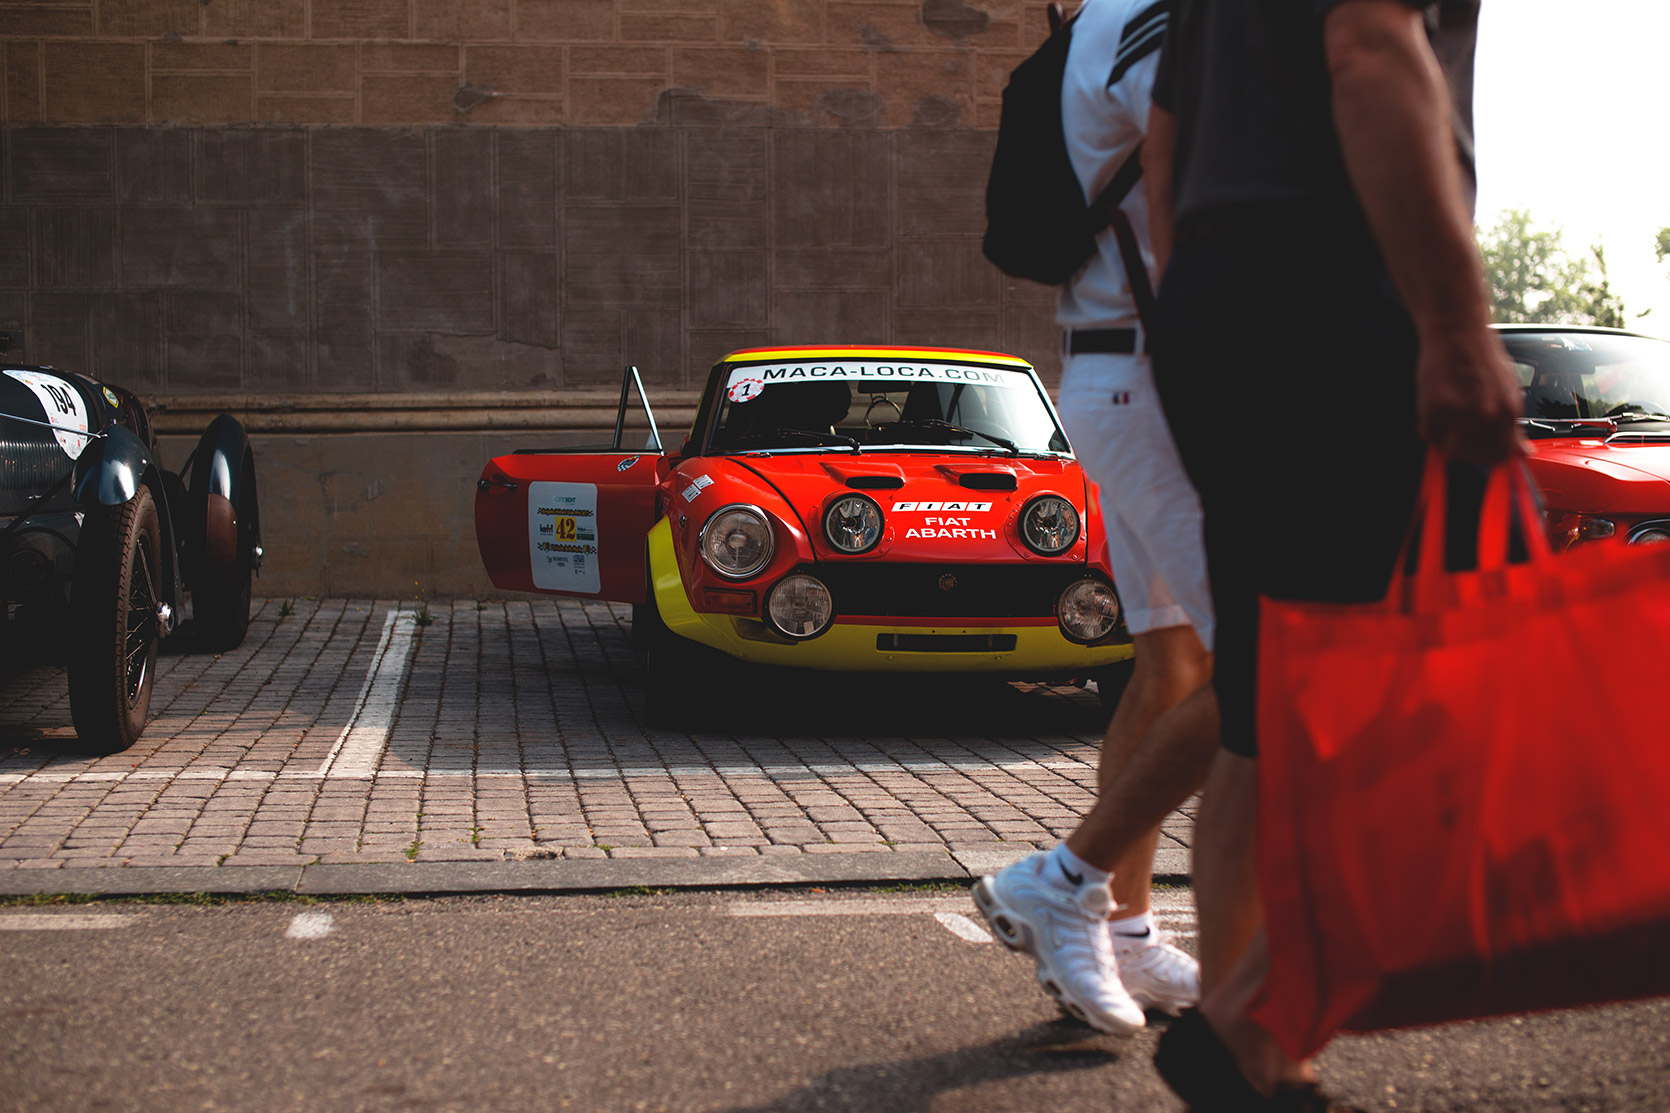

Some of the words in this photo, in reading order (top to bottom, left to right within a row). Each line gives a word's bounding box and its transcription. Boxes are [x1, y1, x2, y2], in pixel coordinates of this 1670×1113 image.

[763, 366, 1005, 383] MACA-LOCA.COM
[741, 383, 751, 396] 1
[40, 384, 77, 416] 194
[897, 503, 988, 511] FIAT
[924, 517, 971, 526] FIAT
[556, 518, 576, 539] 42
[904, 528, 997, 539] ABARTH
